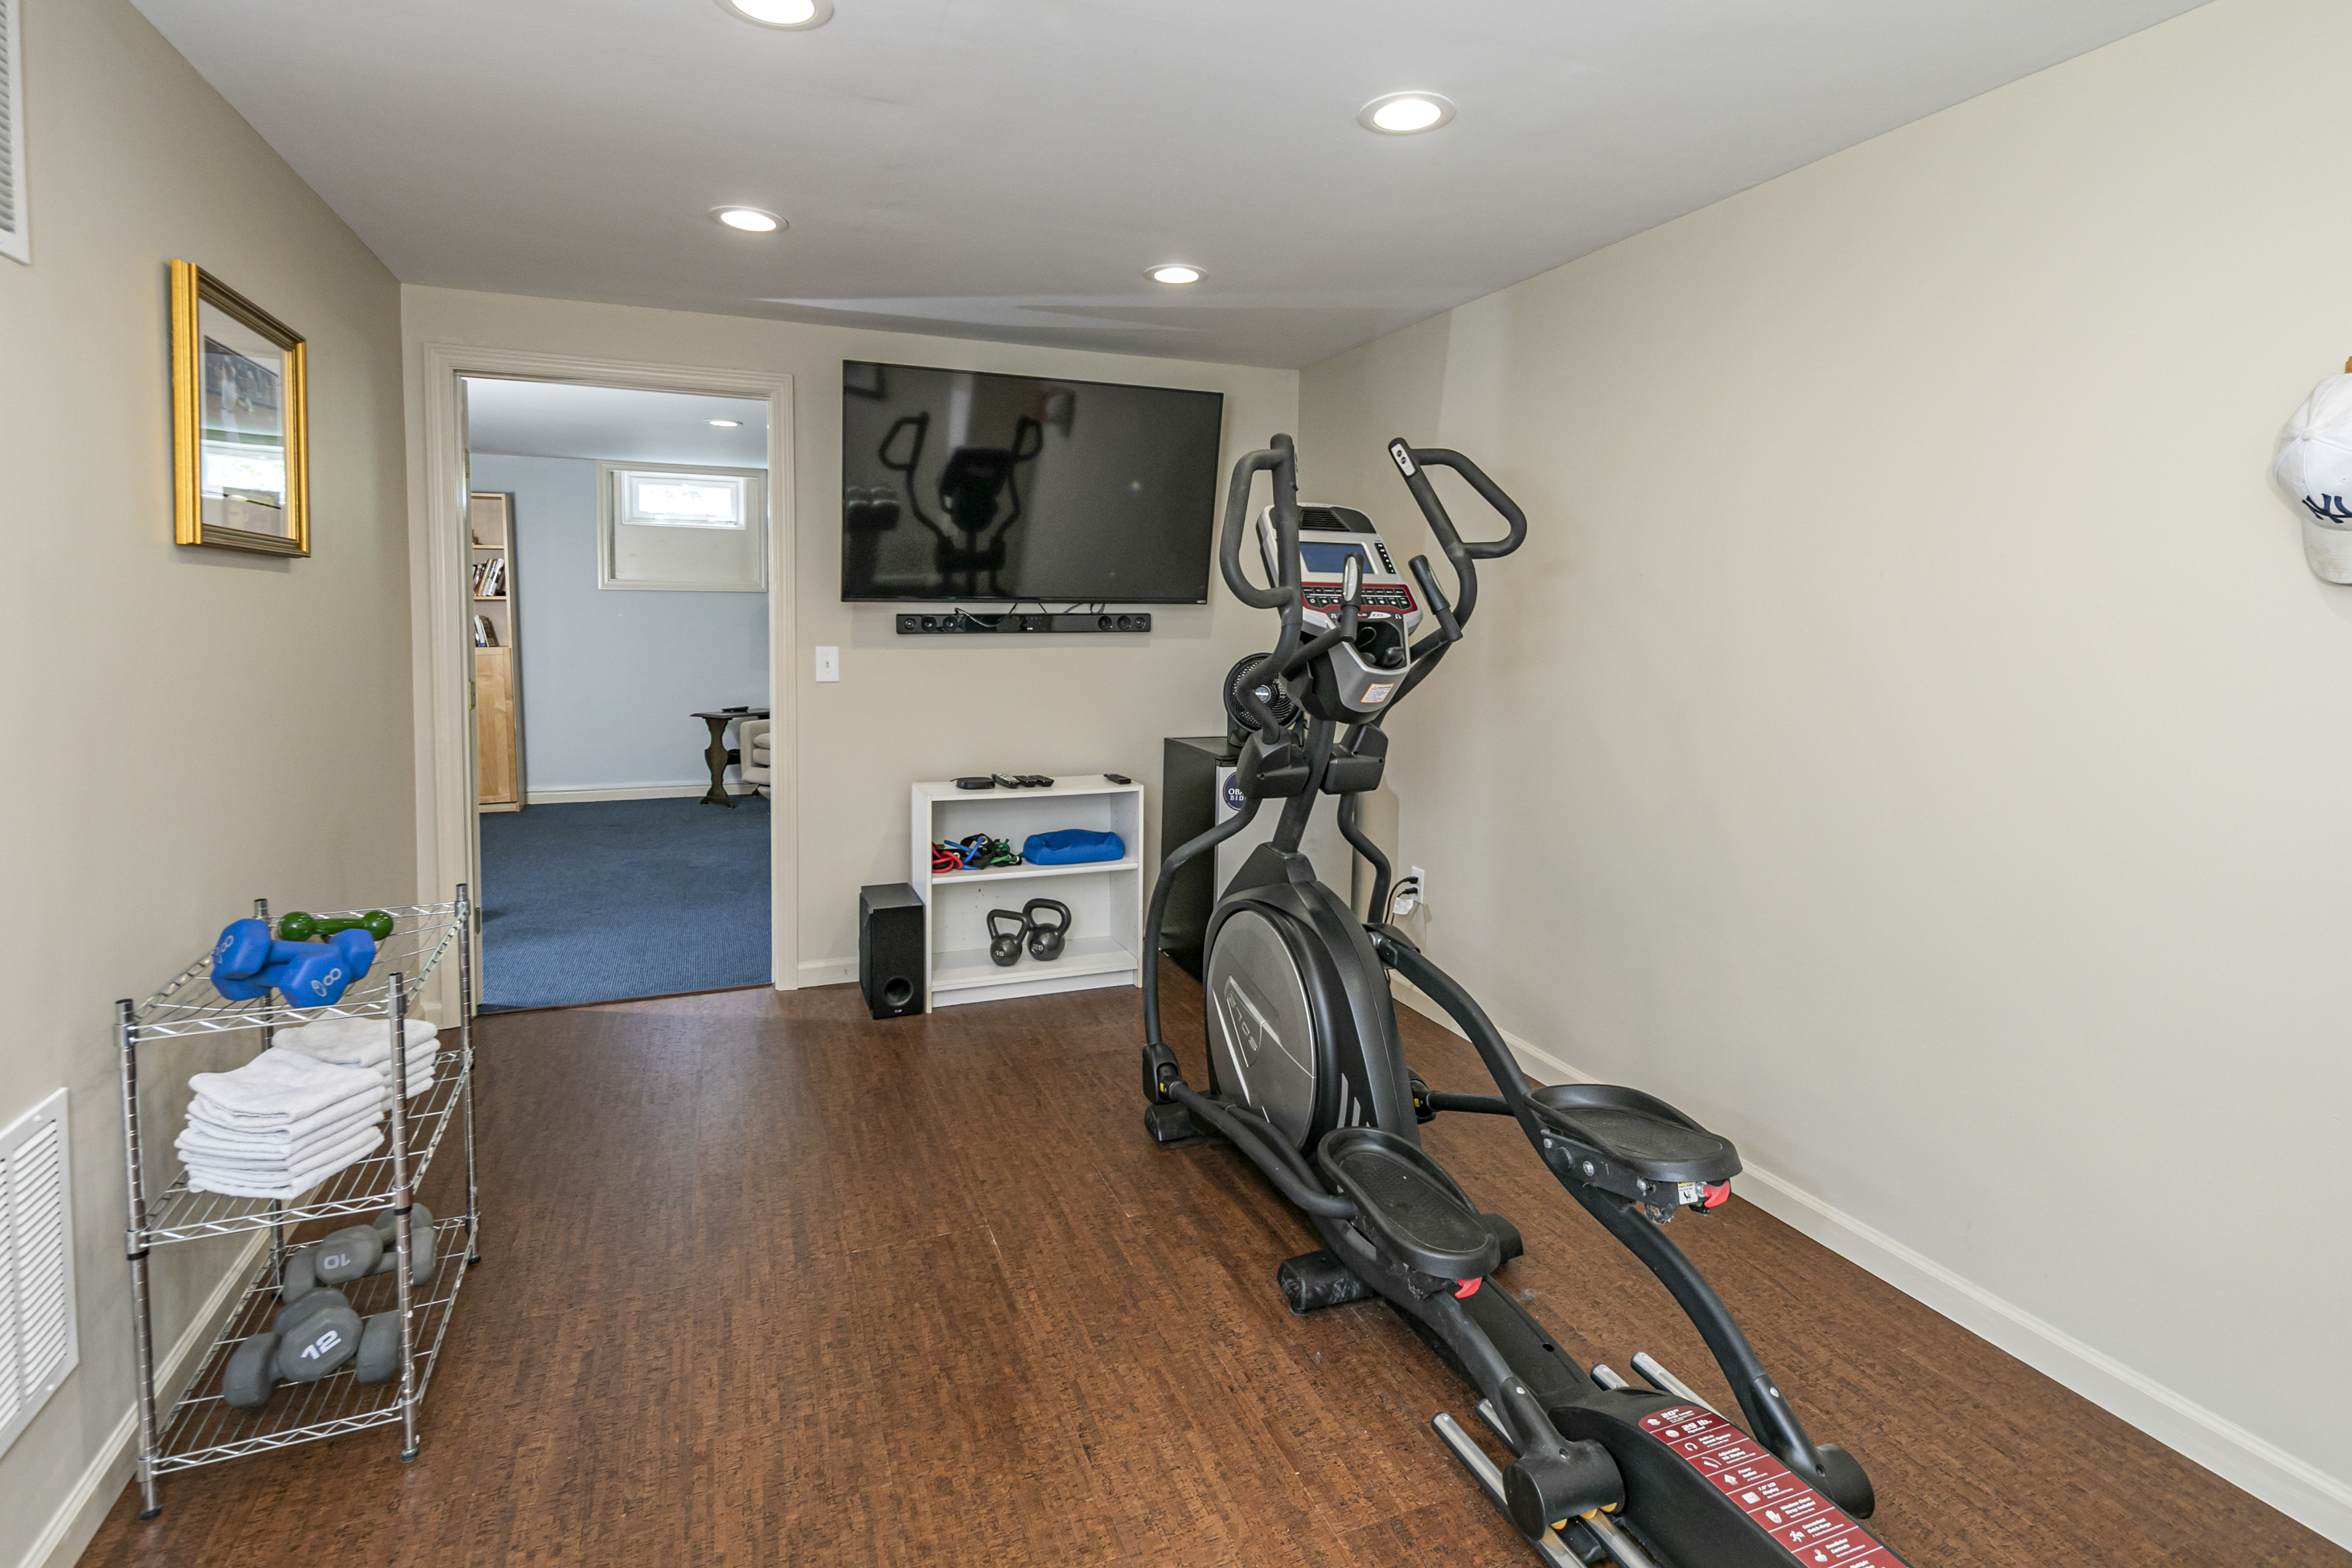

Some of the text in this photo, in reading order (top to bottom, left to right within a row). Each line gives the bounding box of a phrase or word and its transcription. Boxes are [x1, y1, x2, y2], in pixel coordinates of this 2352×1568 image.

[323, 968, 342, 986] 8
[324, 1254, 351, 1270] 10
[300, 1330, 342, 1360] 12
[1681, 1422, 1697, 1431] 29
